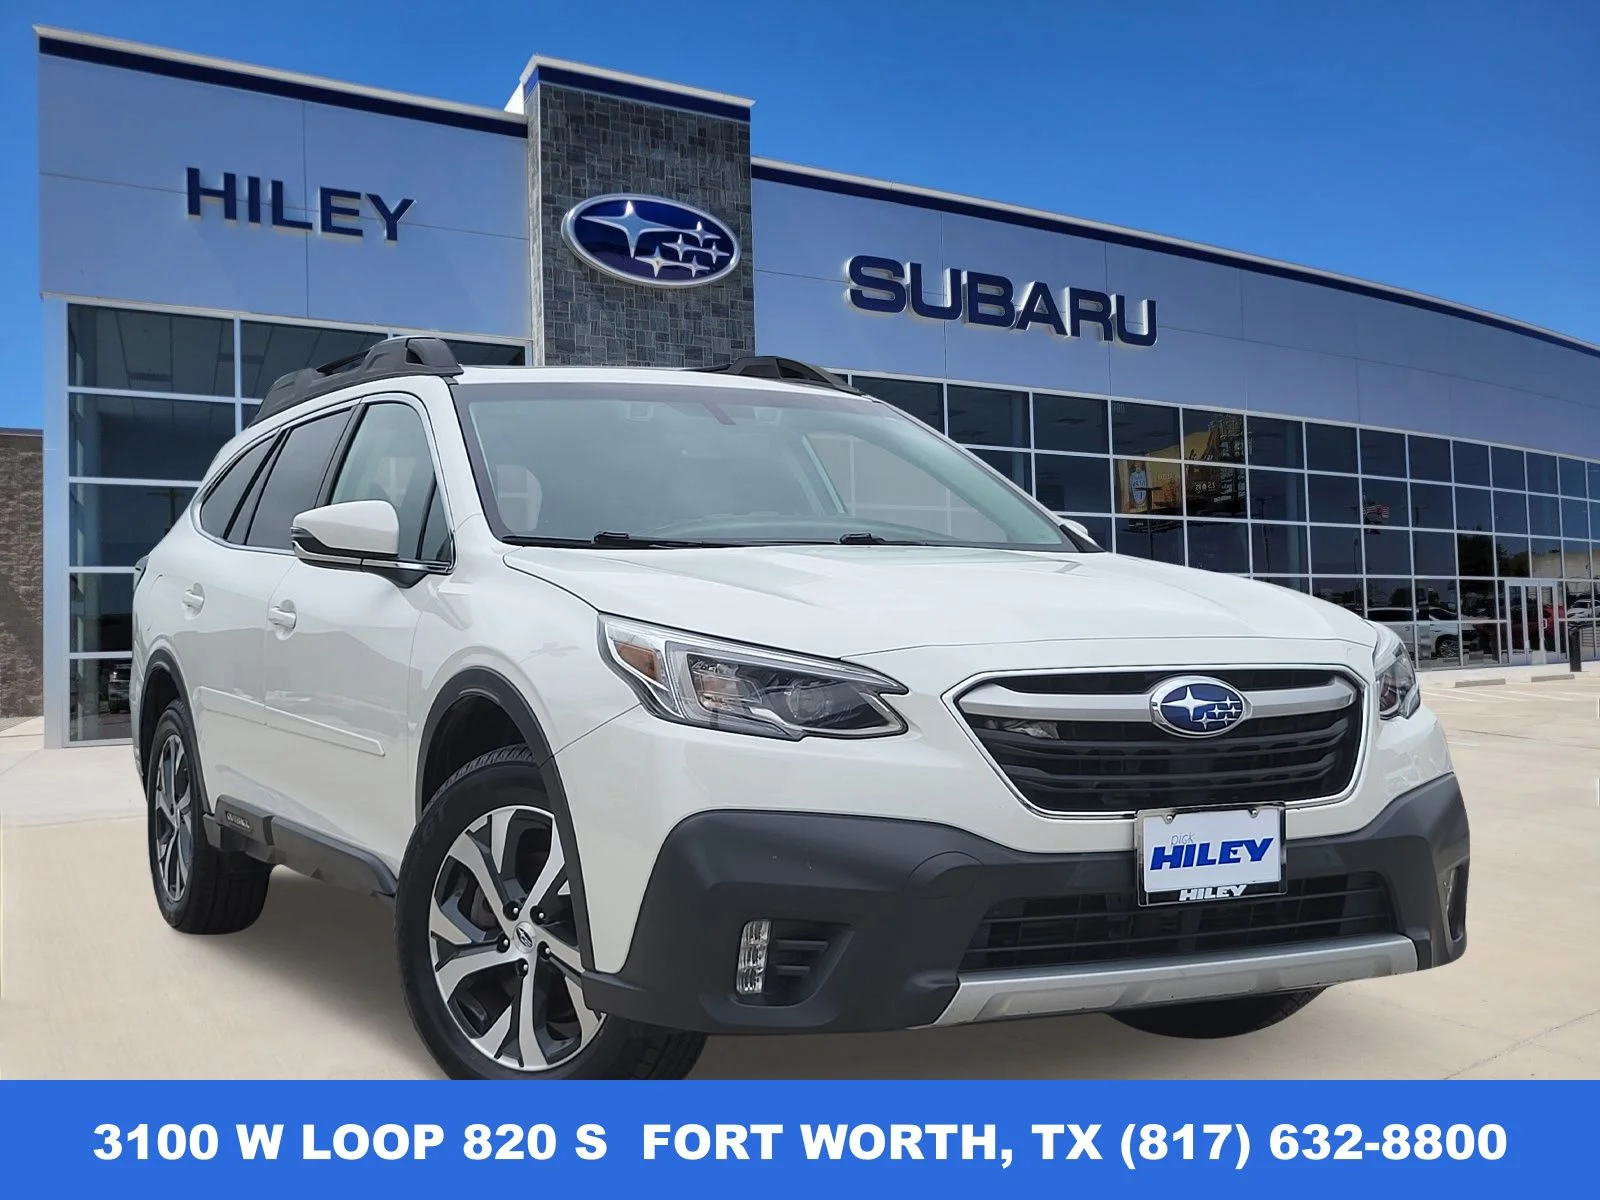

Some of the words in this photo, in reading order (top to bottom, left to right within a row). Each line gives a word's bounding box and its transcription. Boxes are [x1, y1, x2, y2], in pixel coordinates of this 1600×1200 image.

[186, 167, 415, 242] HILEY
[847, 254, 1158, 347] SUBARU
[1150, 838, 1274, 871] HILEY
[1170, 832, 1195, 846] pick
[1179, 884, 1247, 902] HILEY
